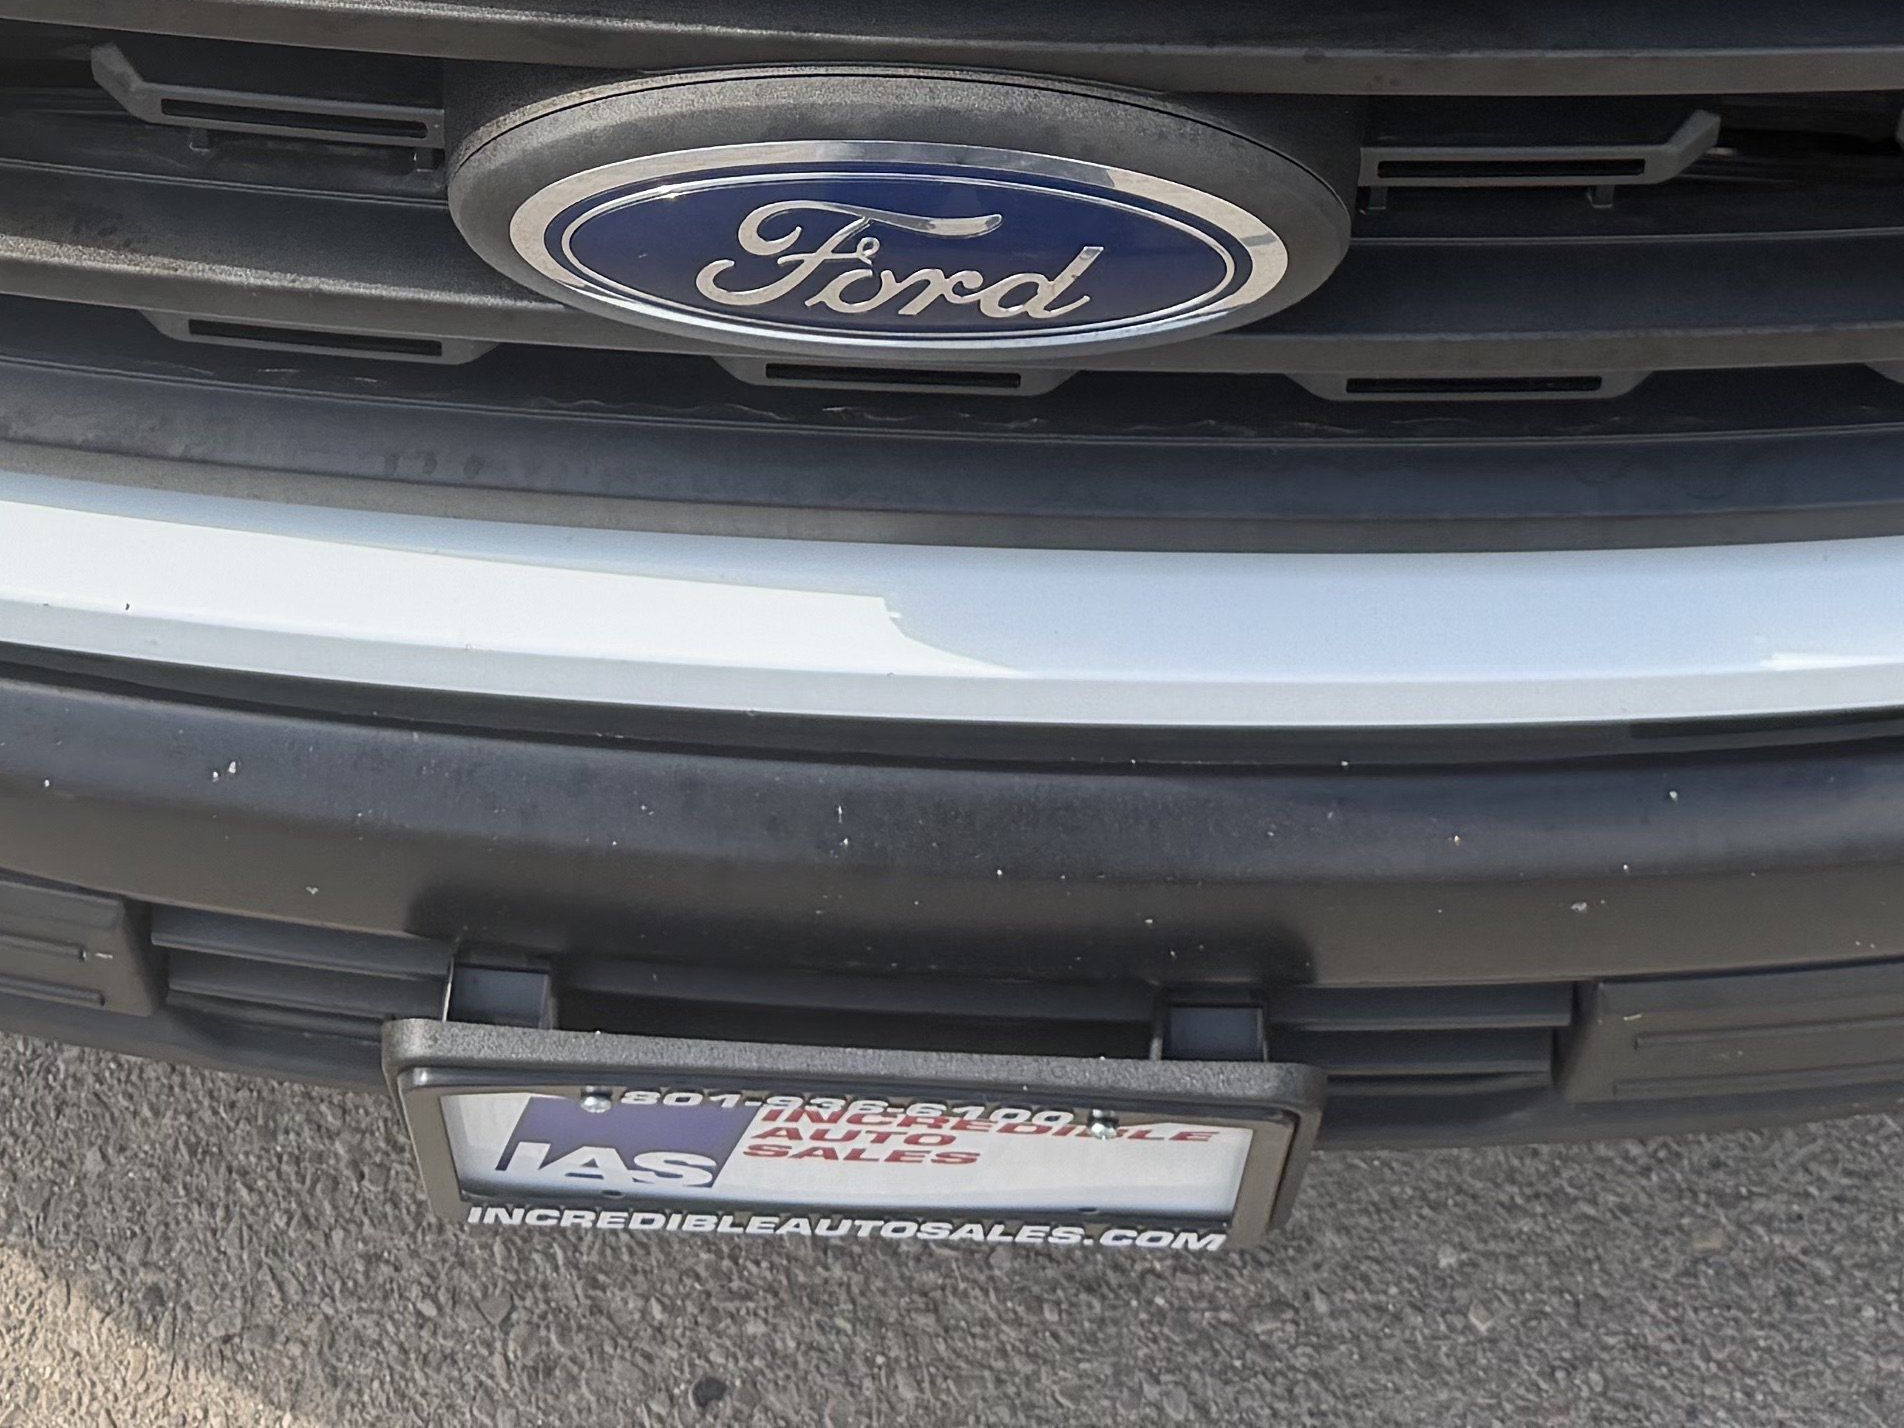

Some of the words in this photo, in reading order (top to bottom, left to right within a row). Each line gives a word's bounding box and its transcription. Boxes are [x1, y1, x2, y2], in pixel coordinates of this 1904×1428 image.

[695, 199, 1104, 319] Ford
[620, 1090, 1075, 1126] 801-936-6100
[742, 1143, 981, 1165] SALES
[750, 1126, 957, 1147] AUTO
[499, 1141, 718, 1189] IAS
[466, 1205, 1228, 1251] INCREDIBLEAUTOSALES.COM
